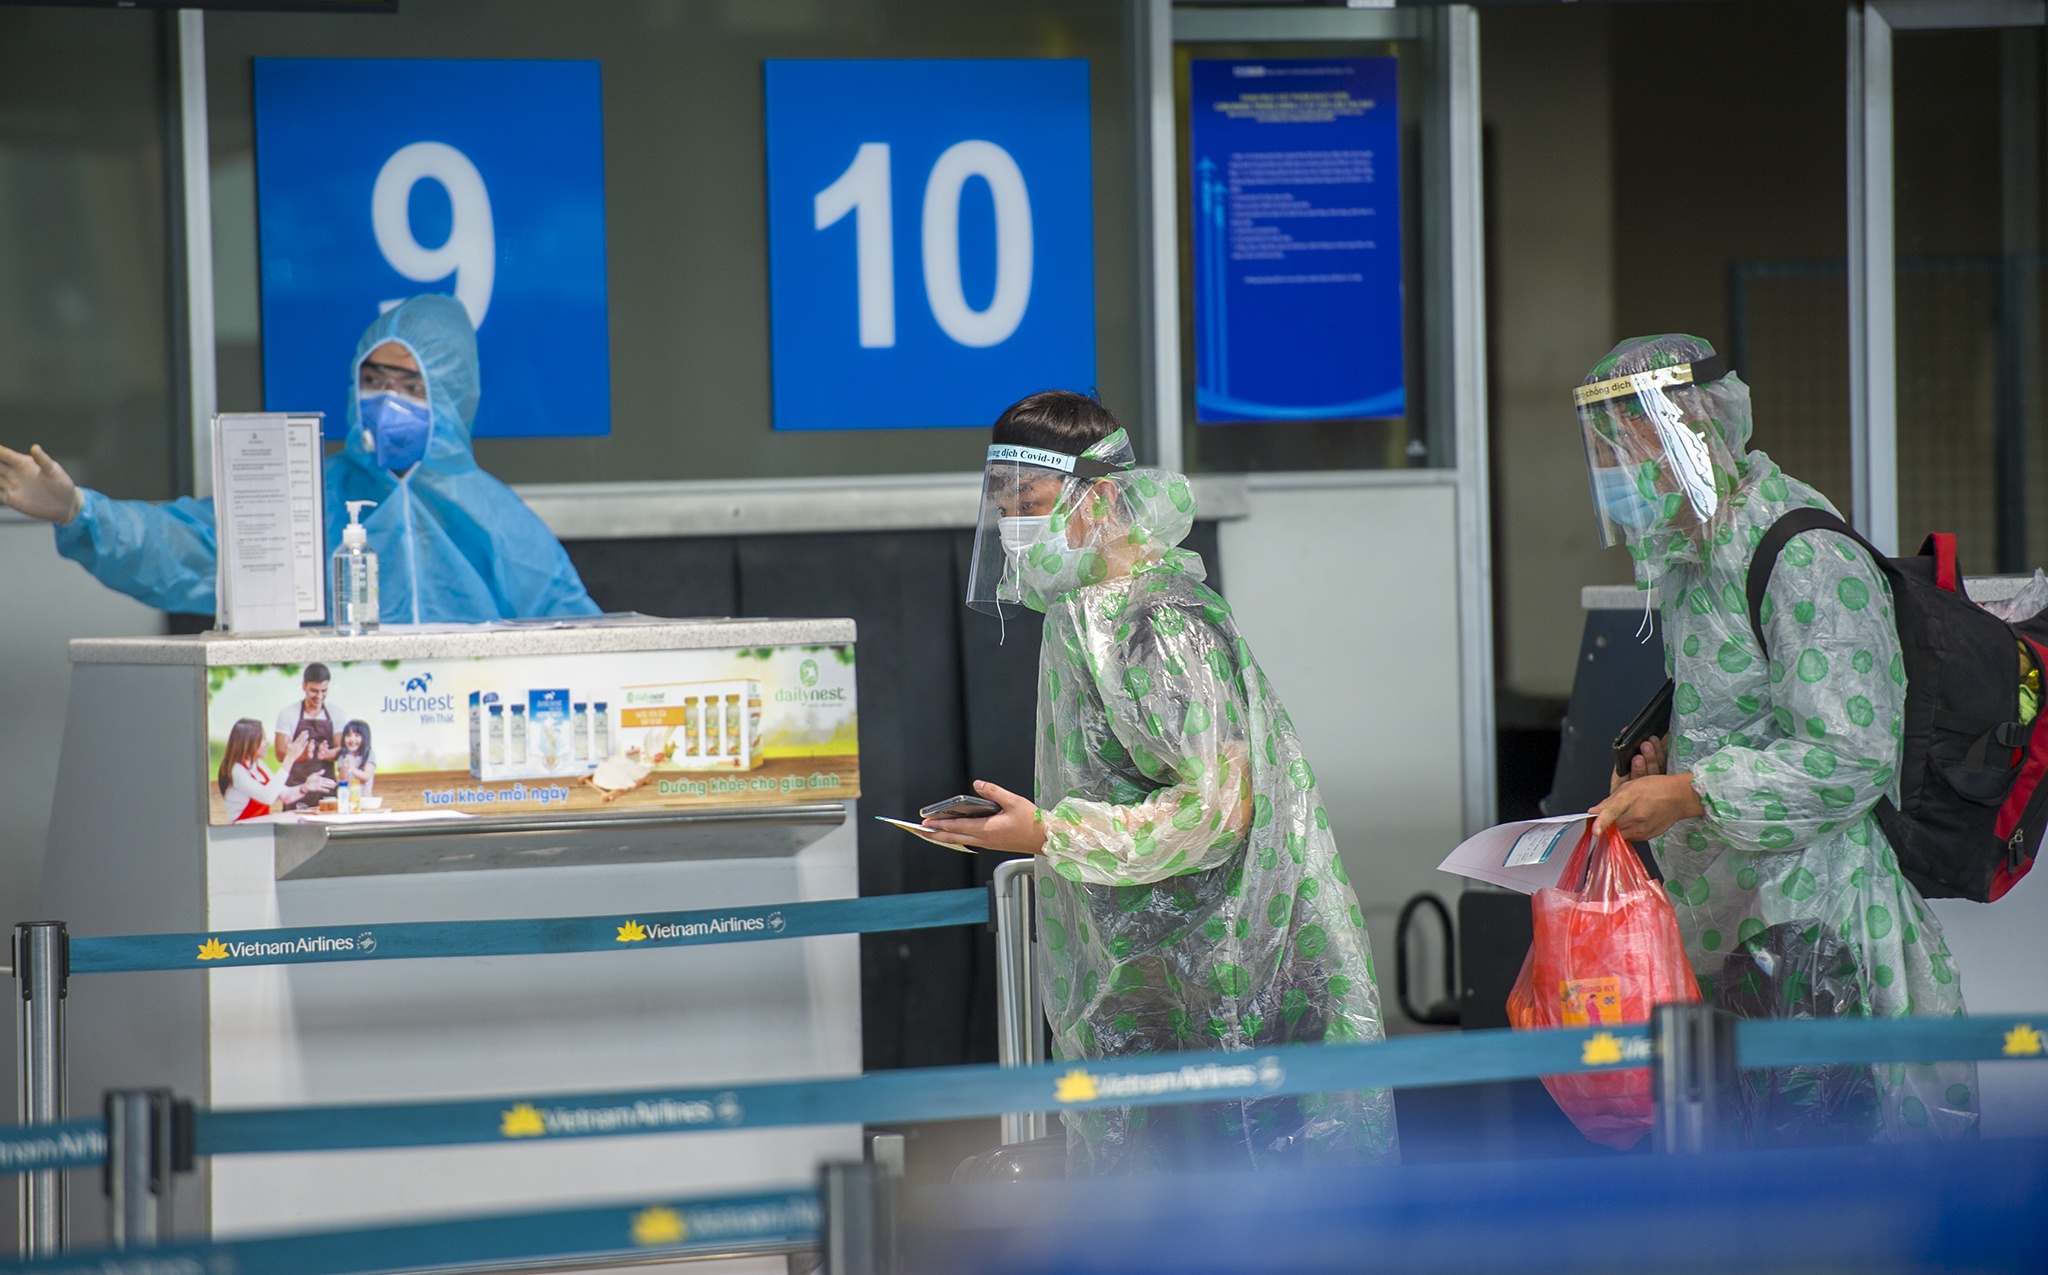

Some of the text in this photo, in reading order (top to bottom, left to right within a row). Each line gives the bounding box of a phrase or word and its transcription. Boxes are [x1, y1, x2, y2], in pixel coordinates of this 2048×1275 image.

[371, 141, 495, 332] 9
[814, 139, 1034, 348] 10
[1611, 380, 1631, 392] dịch
[1001, 448, 1018, 458] dịch
[1020, 449, 1062, 465] Covid-19
[380, 693, 455, 713] Justnest
[775, 687, 846, 706] dailynest
[424, 783, 568, 806] Tươi khỏe mỗi ngày
[659, 772, 841, 796] Dưỡng khỏe cho gia đình
[646, 920, 709, 939] Vietnam
[709, 917, 765, 934] Airlines
[229, 940, 295, 958] Vietnam
[296, 936, 354, 953] Airlines
